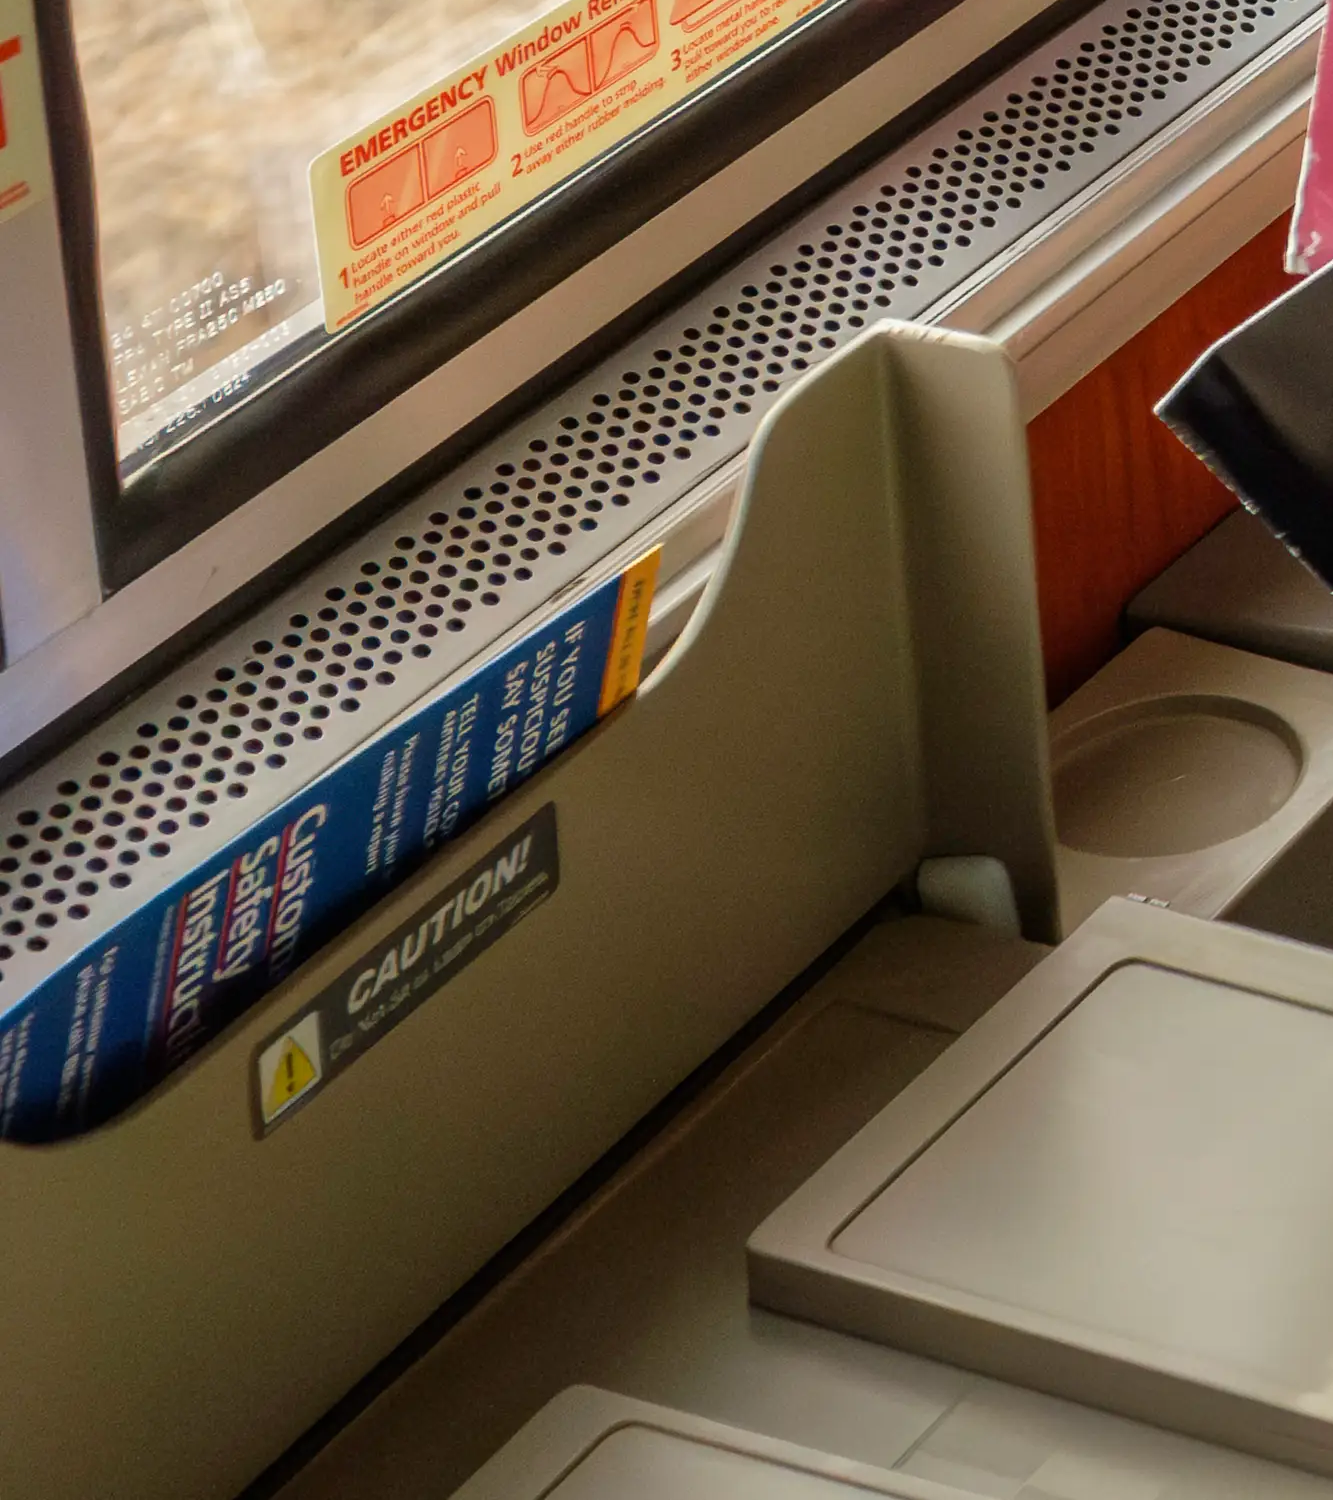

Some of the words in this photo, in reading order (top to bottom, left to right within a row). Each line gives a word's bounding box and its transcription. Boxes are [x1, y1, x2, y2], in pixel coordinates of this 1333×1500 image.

[671, 48, 681, 72] 3
[339, 64, 488, 177] EMERGENCY
[494, 13, 581, 77] Window
[524, 141, 543, 159] Use
[546, 125, 562, 144] red
[565, 103, 600, 132] handle
[601, 95, 613, 108] to
[615, 79, 637, 101] strip
[511, 153, 523, 178] 2
[525, 150, 553, 175] away
[555, 129, 585, 155] either
[588, 105, 621, 133] rubber
[351, 243, 388, 275] Locate
[391, 220, 423, 246] either
[426, 204, 444, 223] red
[447, 182, 481, 211] plastic
[353, 257, 392, 288] handle
[395, 246, 409, 261] on
[412, 215, 455, 249] window
[458, 199, 478, 219] and
[481, 182, 501, 208] pull
[339, 267, 349, 290] 1
[354, 273, 393, 305] handle
[396, 242, 435, 276] toward
[152, 311, 195, 345] TYPE
[564, 620, 588, 644] IF
[501, 660, 529, 710] SAY
[517, 640, 556, 775] SUSPICIOU
[553, 646, 580, 707] YOU
[456, 692, 480, 743] TELL
[446, 739, 471, 801] YOUR
[212, 835, 281, 982] Safety
[347, 834, 532, 1015] CAUTION!
